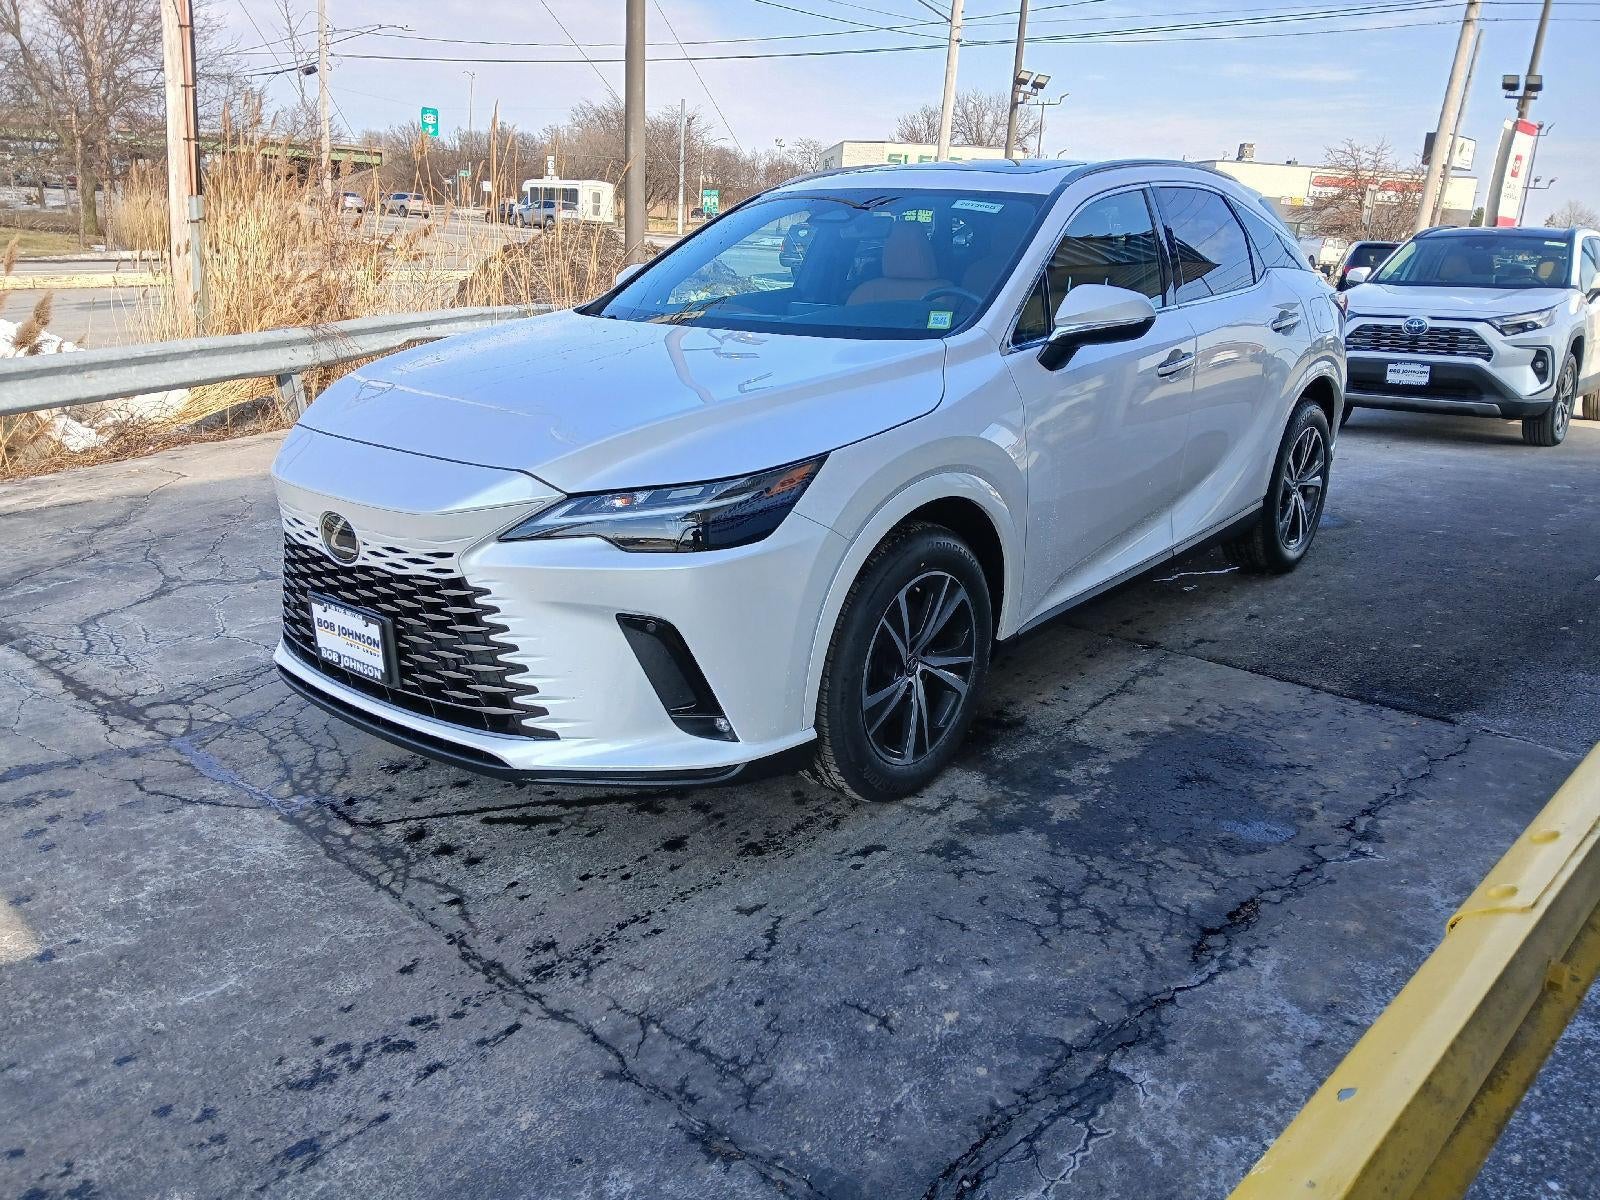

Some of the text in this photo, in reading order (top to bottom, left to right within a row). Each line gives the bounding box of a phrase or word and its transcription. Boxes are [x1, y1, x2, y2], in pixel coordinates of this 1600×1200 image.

[316, 617, 380, 650] BOB JOHNSON
[321, 647, 382, 680] BOB JOHNSON
